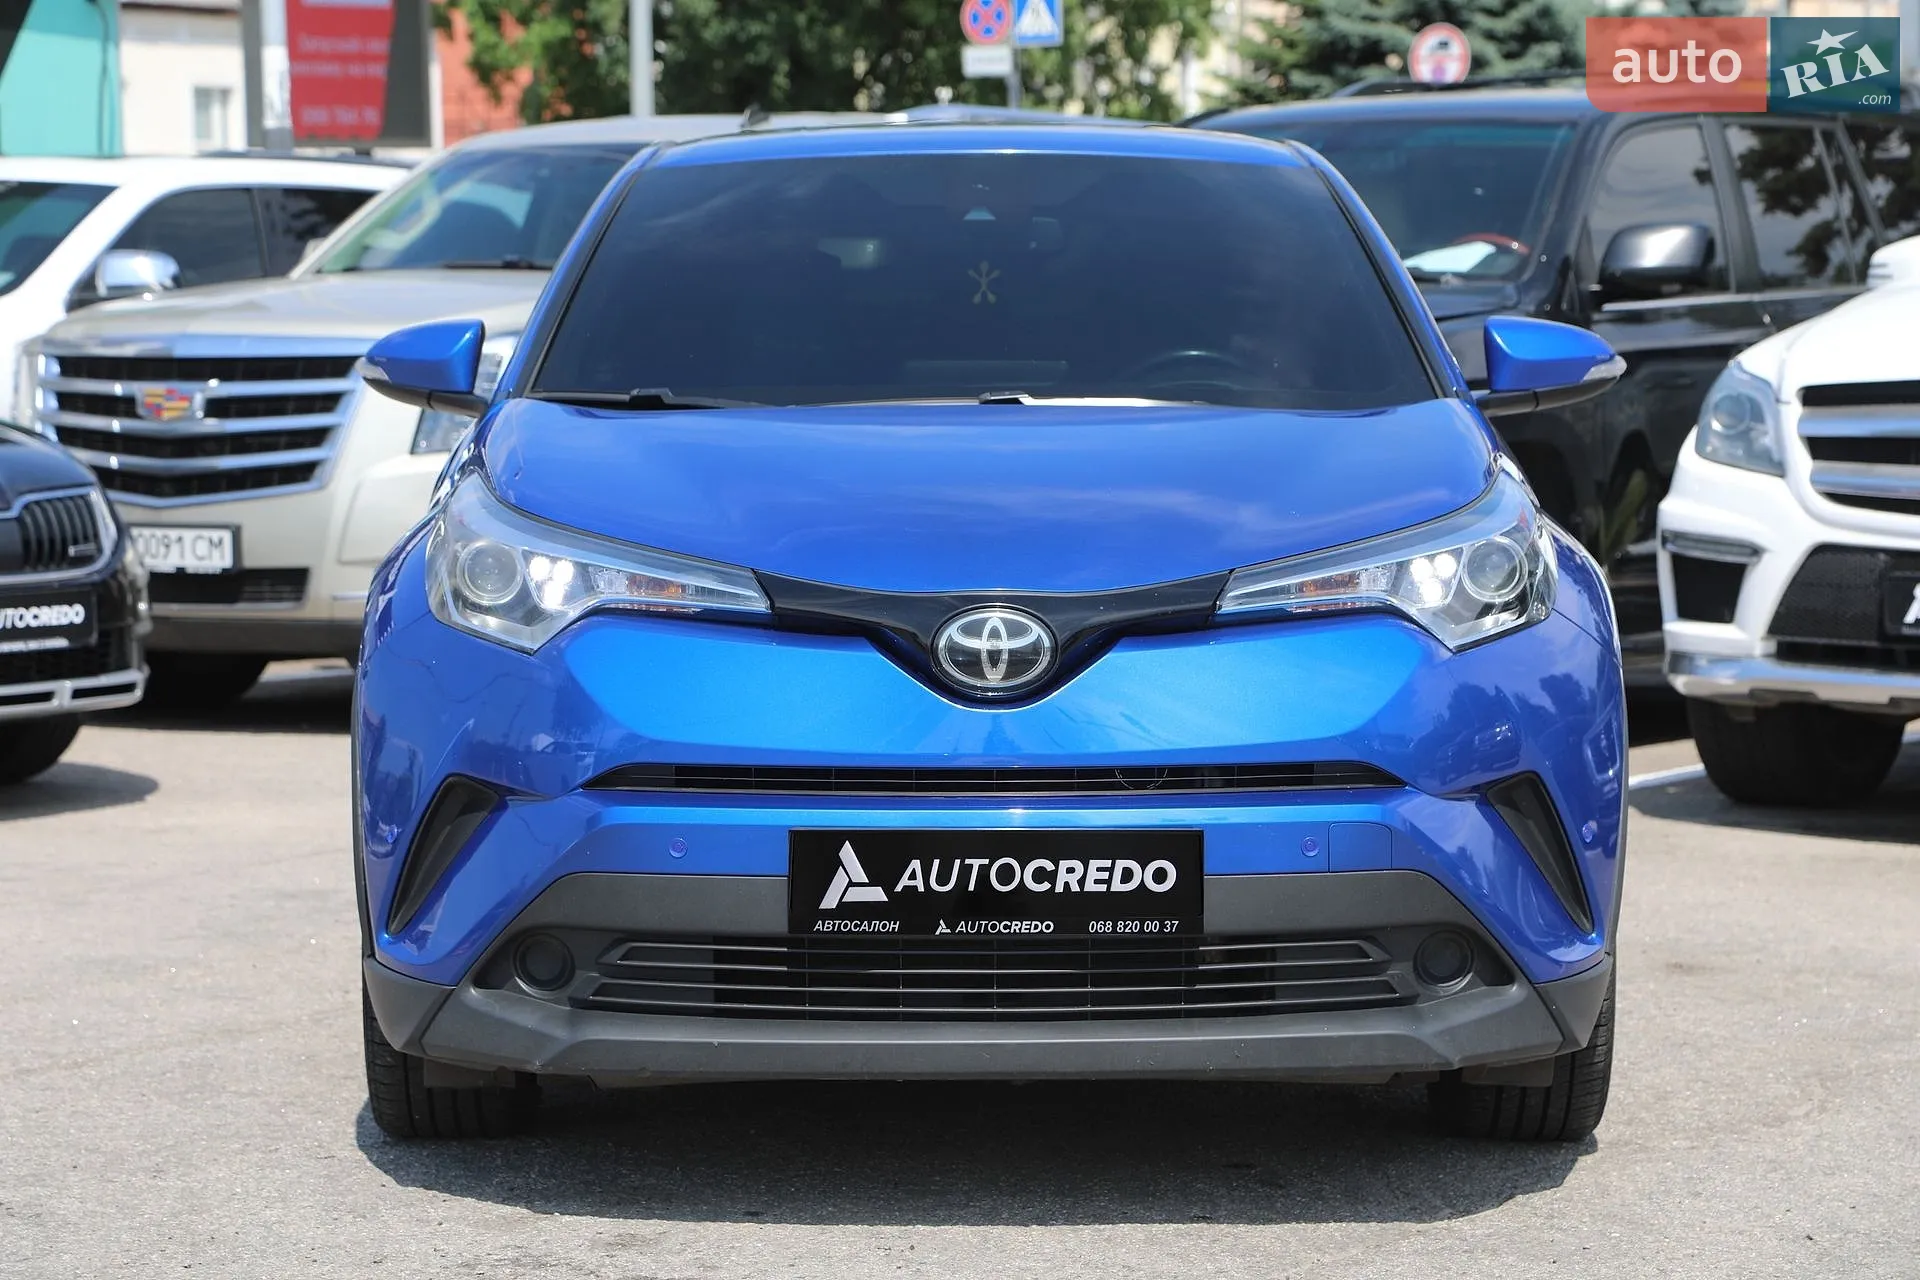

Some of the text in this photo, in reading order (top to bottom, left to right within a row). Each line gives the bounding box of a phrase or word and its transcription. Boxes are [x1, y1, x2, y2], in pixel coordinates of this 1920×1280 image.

[191, 533, 226, 562] CM
[893, 856, 1177, 893] AUTOCREDO
[813, 919, 900, 932] АВТОСАЛОН
[955, 920, 1055, 934] AUTOCREDO
[1088, 920, 1179, 933] 068 820 00 37
